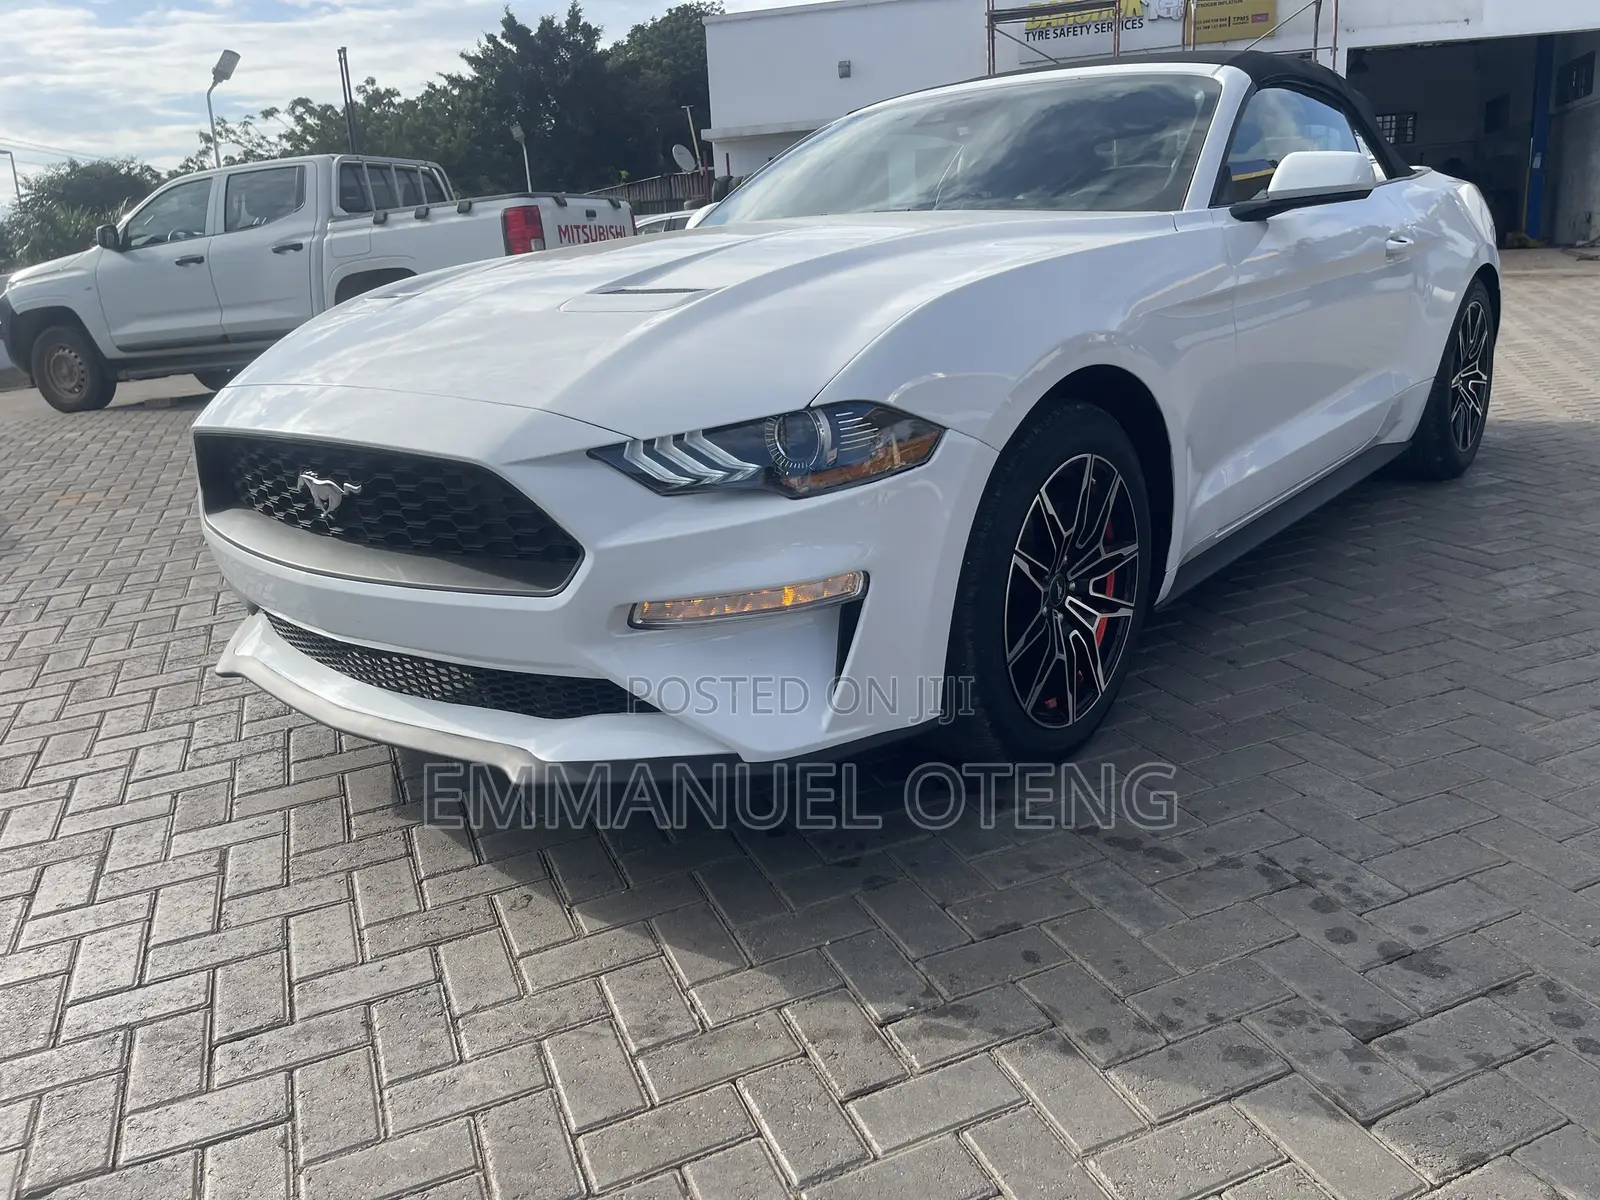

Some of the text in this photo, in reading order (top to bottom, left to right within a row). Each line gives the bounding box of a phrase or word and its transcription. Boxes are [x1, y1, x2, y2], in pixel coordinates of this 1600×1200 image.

[1025, 18, 1144, 42] TYRE SAFETY SERICES
[557, 224, 626, 243] MITSUBISHI
